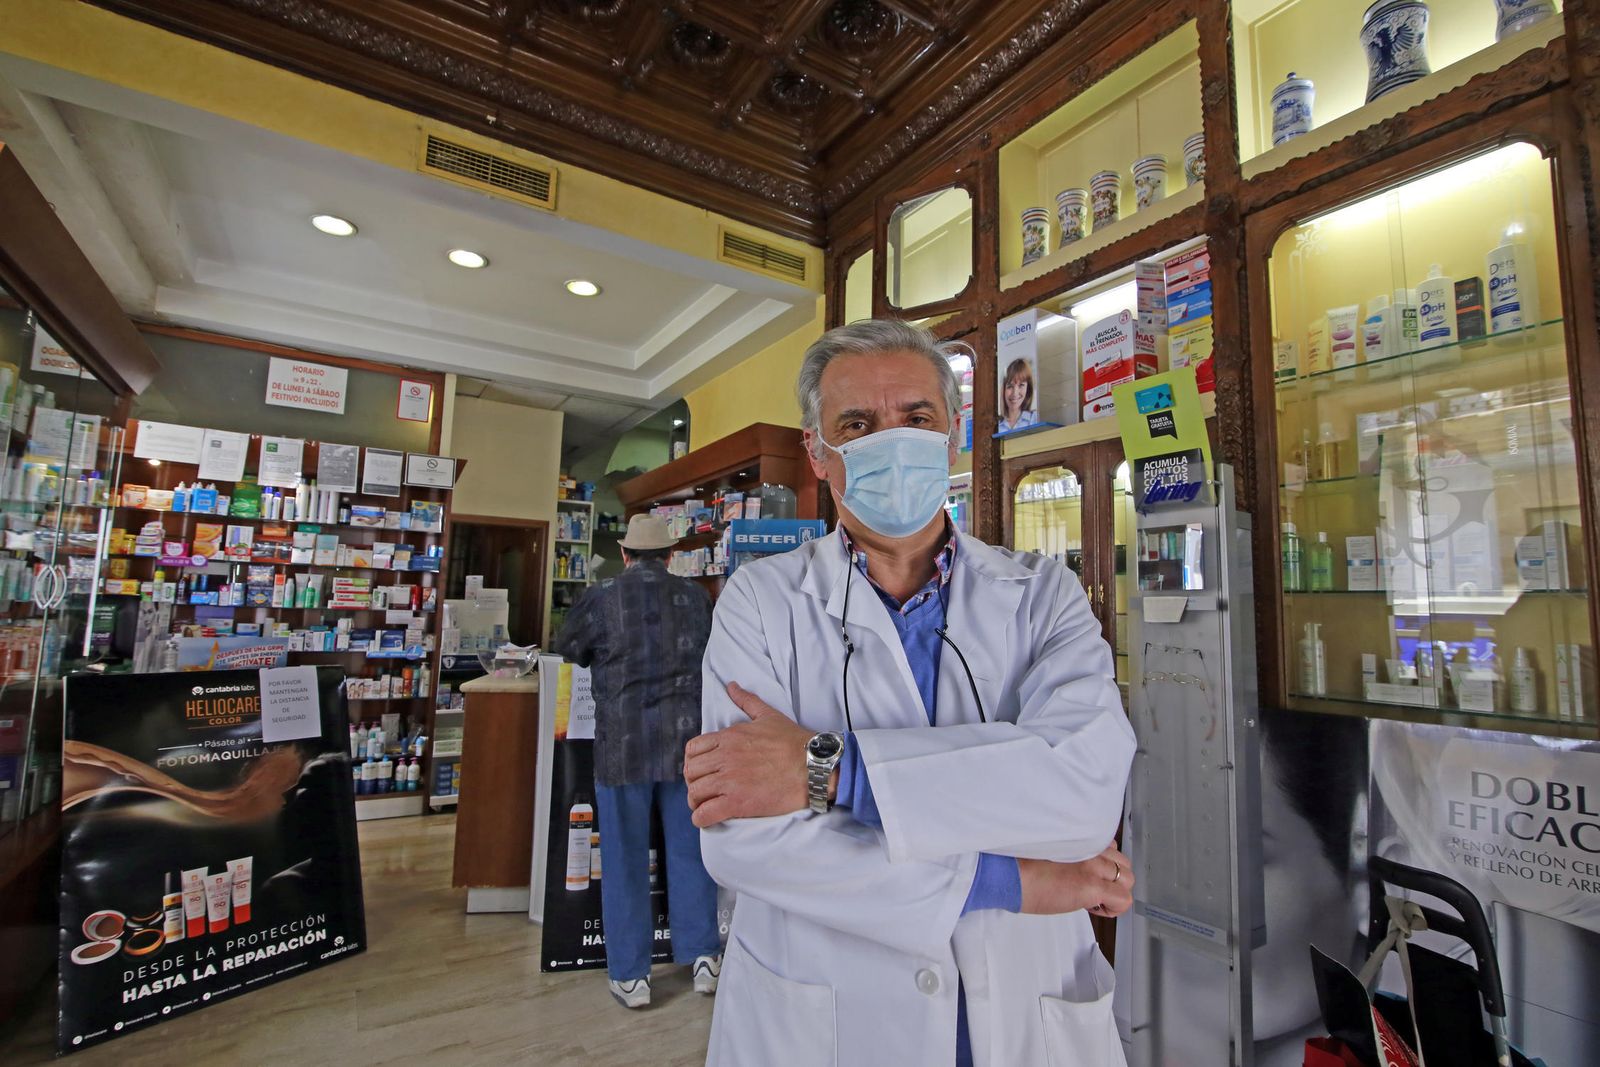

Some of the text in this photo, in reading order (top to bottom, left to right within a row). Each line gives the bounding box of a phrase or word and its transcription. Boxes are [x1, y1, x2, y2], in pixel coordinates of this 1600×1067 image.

[292, 365, 325, 377] HORARIO
[272, 382, 281, 390] DE
[283, 384, 305, 393] LUNES
[271, 392, 339, 408] FESTIVOS INCLUIDOS
[1143, 455, 1188, 471] ACUMULA
[1143, 463, 1188, 480] PUNTOS
[1168, 472, 1188, 484] TUS
[735, 534, 797, 545] BETER
[205, 685, 241, 694] cantabria
[269, 687, 309, 696] MANTENGAN
[185, 696, 260, 718] HELIOCARE
[279, 695, 310, 704] DISTANCIA
[208, 717, 242, 726] COLOR
[204, 737, 246, 748] Pásate al
[1471, 770, 1600, 817] DOBL
[1448, 800, 1600, 854] EFICAC
[1451, 836, 1566, 870] RENOVACIÓN
[1449, 851, 1461, 862] Y
[1463, 854, 1534, 880] RELLENO
[1539, 870, 1563, 887] DE
[123, 913, 326, 984] DESDE LA PROTECCIÓN
[320, 945, 347, 960] cantabria
[122, 972, 187, 1004] HASTA
[192, 963, 217, 981] LA
[222, 928, 327, 972] REPARACIÓN
